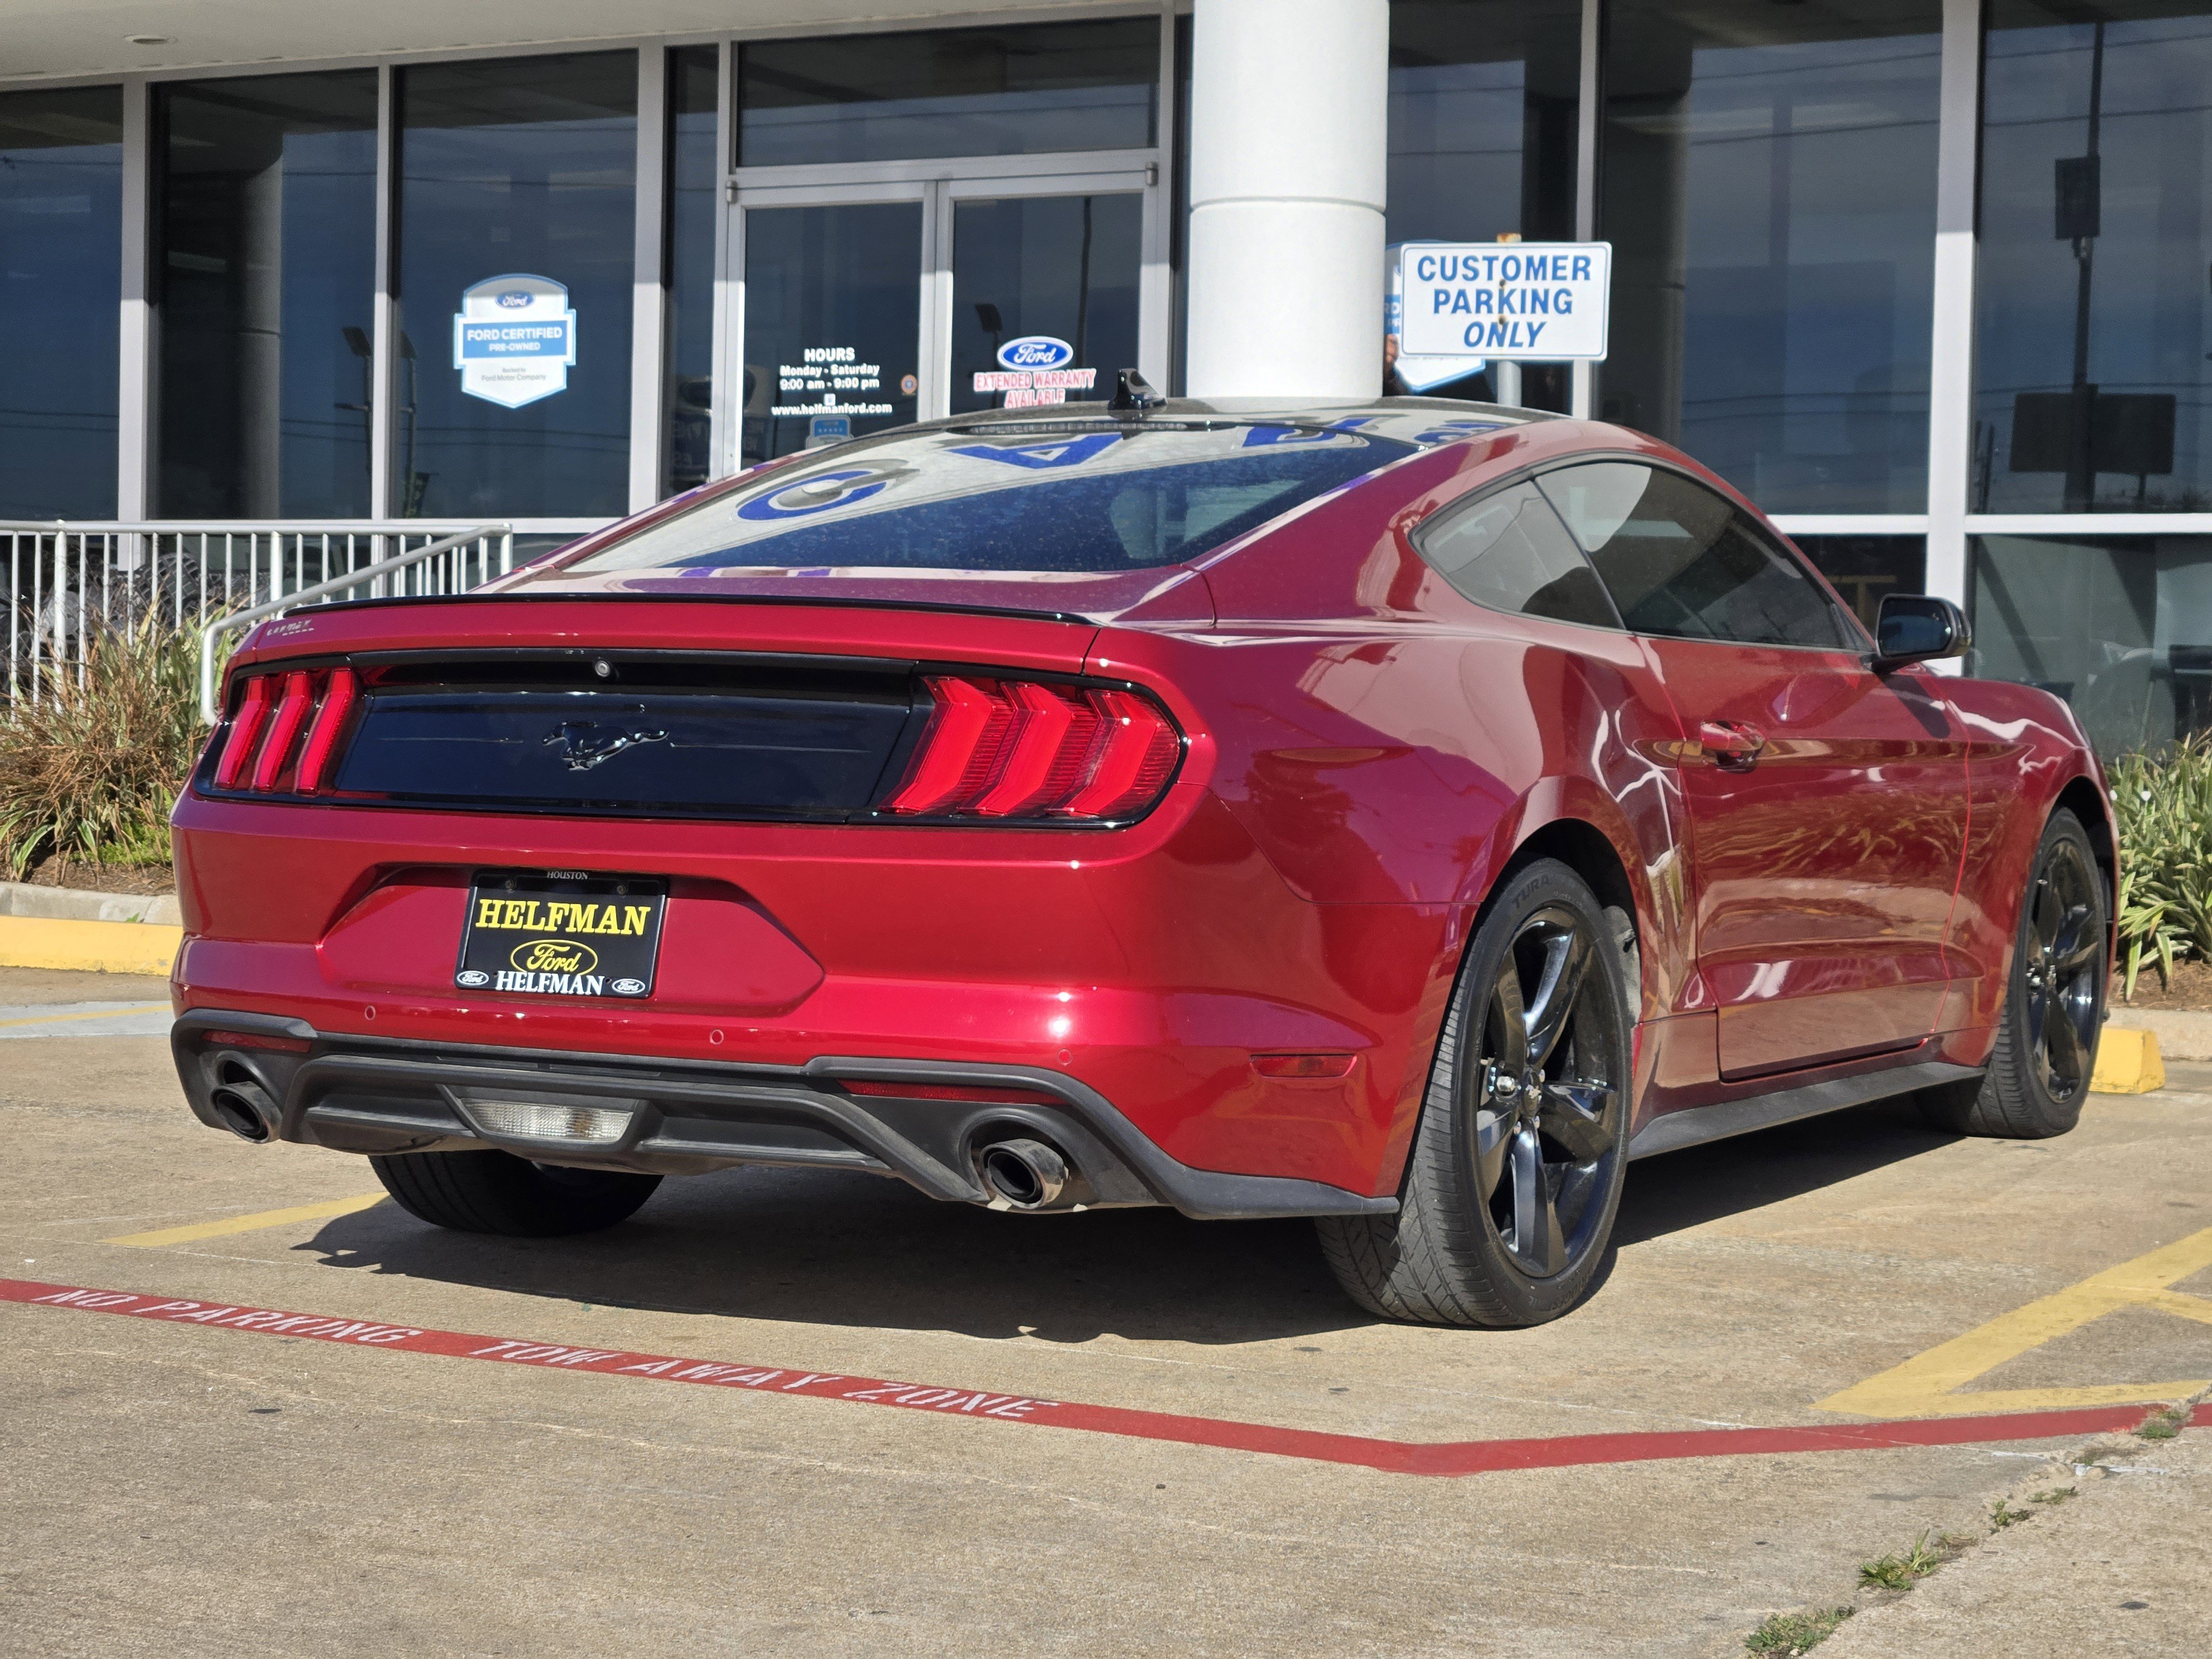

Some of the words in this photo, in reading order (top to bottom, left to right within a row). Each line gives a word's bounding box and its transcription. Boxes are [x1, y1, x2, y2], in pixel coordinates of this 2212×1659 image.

[1417, 255, 1591, 281] CUSTOMER
[502, 295, 528, 306] Ford
[1433, 288, 1573, 314] PARKING
[467, 329, 500, 341] FORD
[502, 327, 562, 340] CERTIFIED
[1464, 321, 1547, 348] ONLY
[489, 342, 541, 352] PRE-OWNED
[804, 347, 855, 362] HOURS
[1013, 343, 1056, 364] Ford
[780, 365, 822, 377] Monday
[830, 363, 880, 376] Saturday
[976, 372, 1031, 390] EXTENDED
[1034, 369, 1096, 388] WARRANTY
[806, 379, 825, 389] am
[861, 378, 879, 390] pm
[1006, 389, 1065, 408] AVAILABLE
[771, 404, 892, 415] www.helfmanford.com
[547, 871, 589, 880] HOUSTON
[476, 899, 651, 936] HELFMAN
[527, 943, 582, 972] Ford
[462, 973, 483, 984] Ford
[495, 971, 604, 995] HELFMAN
[617, 980, 639, 992] Ford
[31, 1290, 138, 1307] NO
[129, 1301, 424, 1343] PARKING
[468, 1340, 623, 1365] TOW
[615, 1359, 844, 1389] AWAY
[842, 1382, 1061, 1418] ZONE
